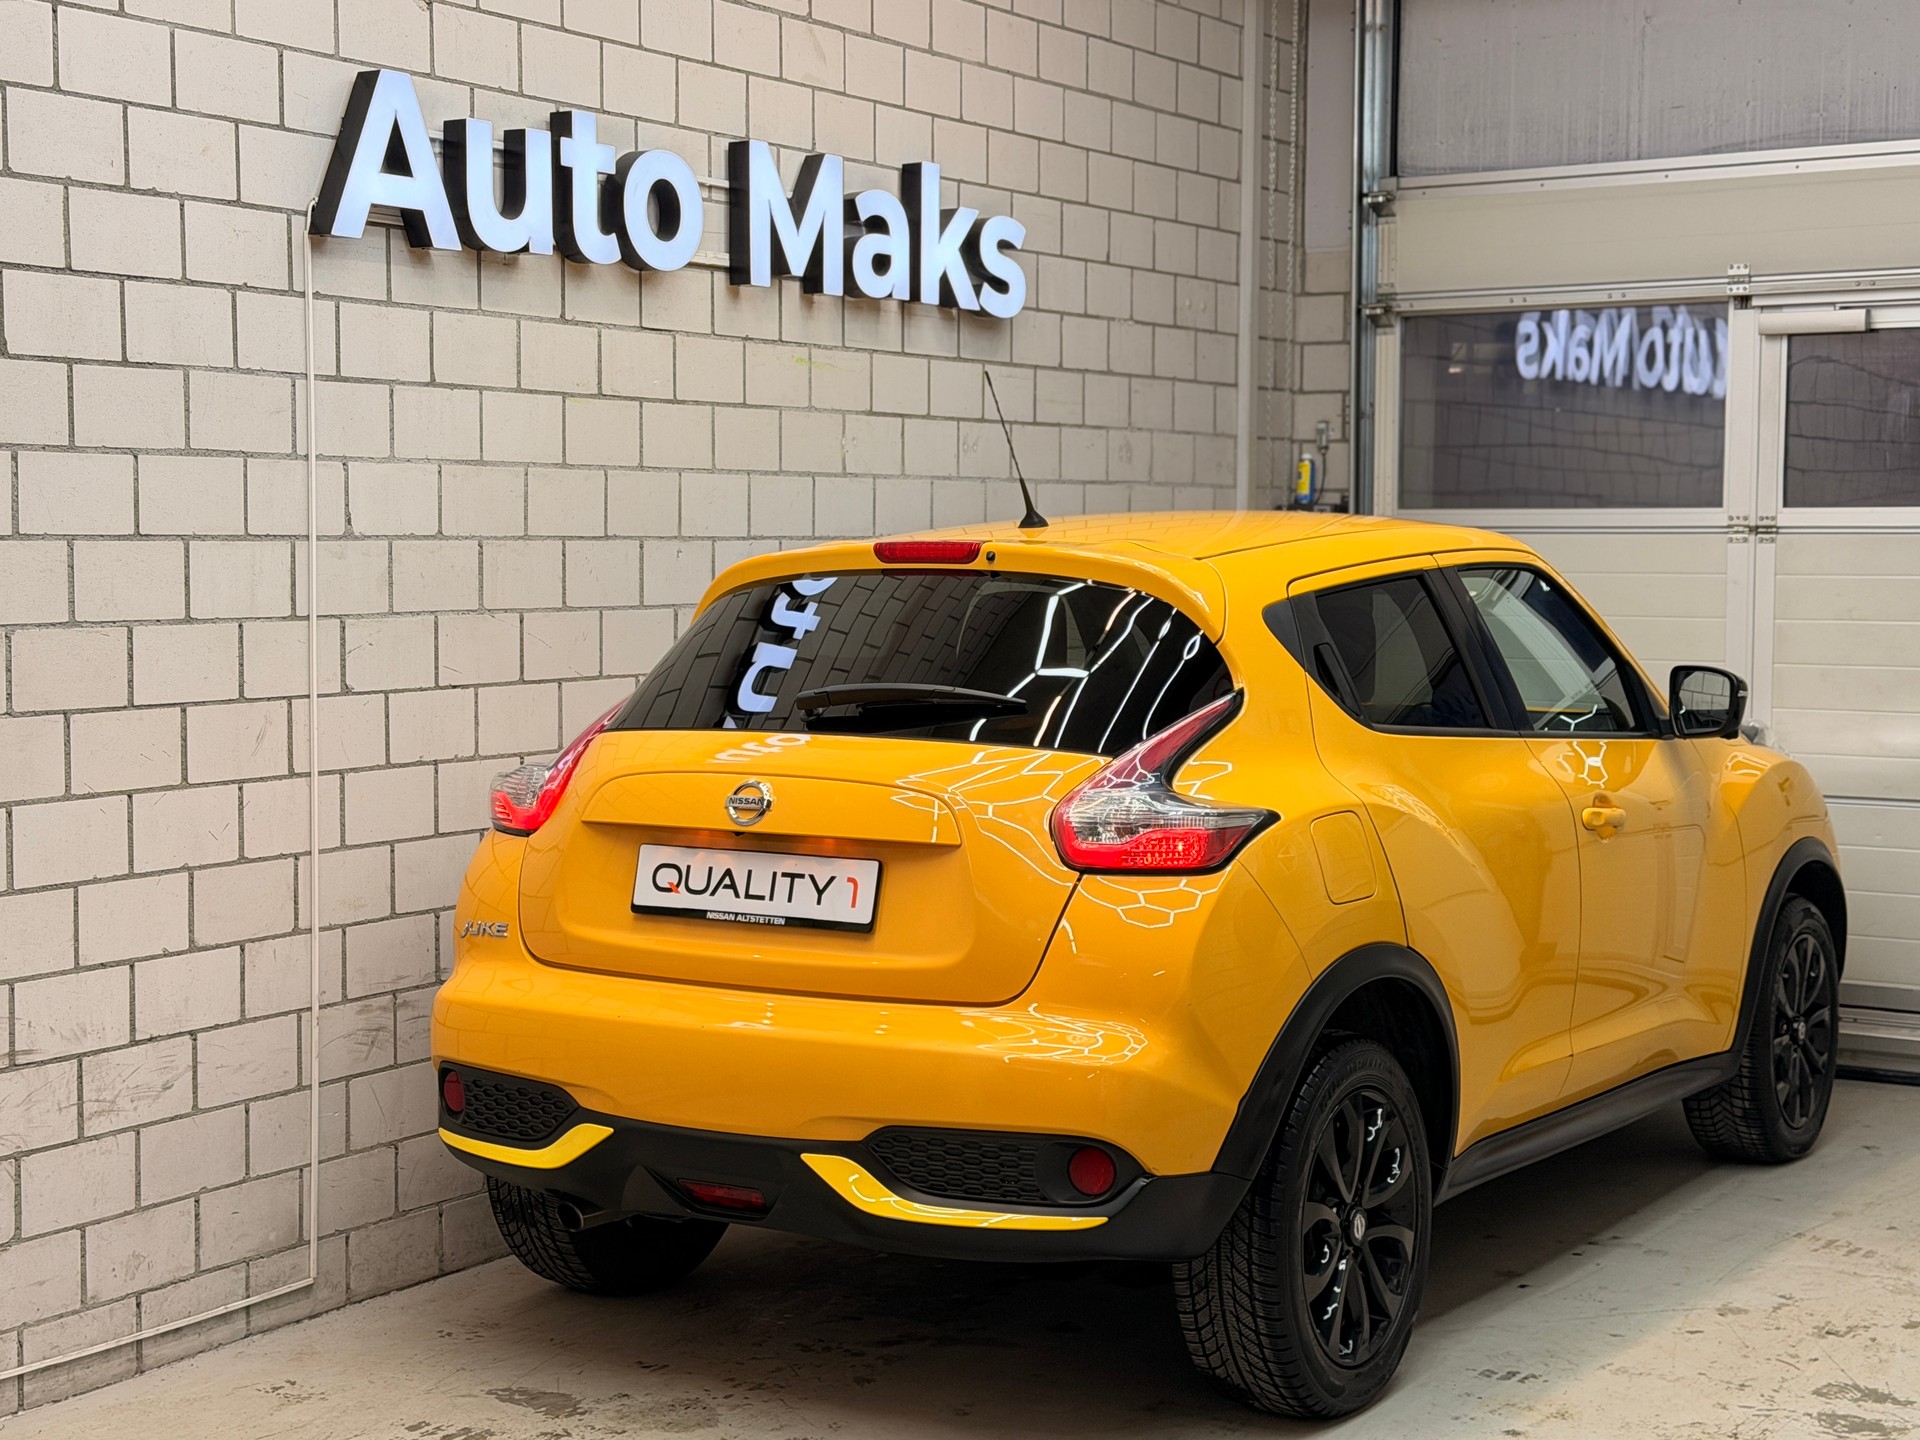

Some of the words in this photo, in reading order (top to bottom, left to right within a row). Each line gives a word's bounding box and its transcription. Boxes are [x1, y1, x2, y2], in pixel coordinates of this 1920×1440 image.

[309, 69, 703, 272] Auto
[728, 139, 1027, 318] Maks
[728, 797, 765, 806] NISSAN
[652, 862, 837, 906] QUALITY
[846, 876, 859, 908] 1
[706, 911, 735, 921] NISSAN
[736, 914, 786, 925] ALTSTETTEN
[460, 920, 509, 939] JUKE
